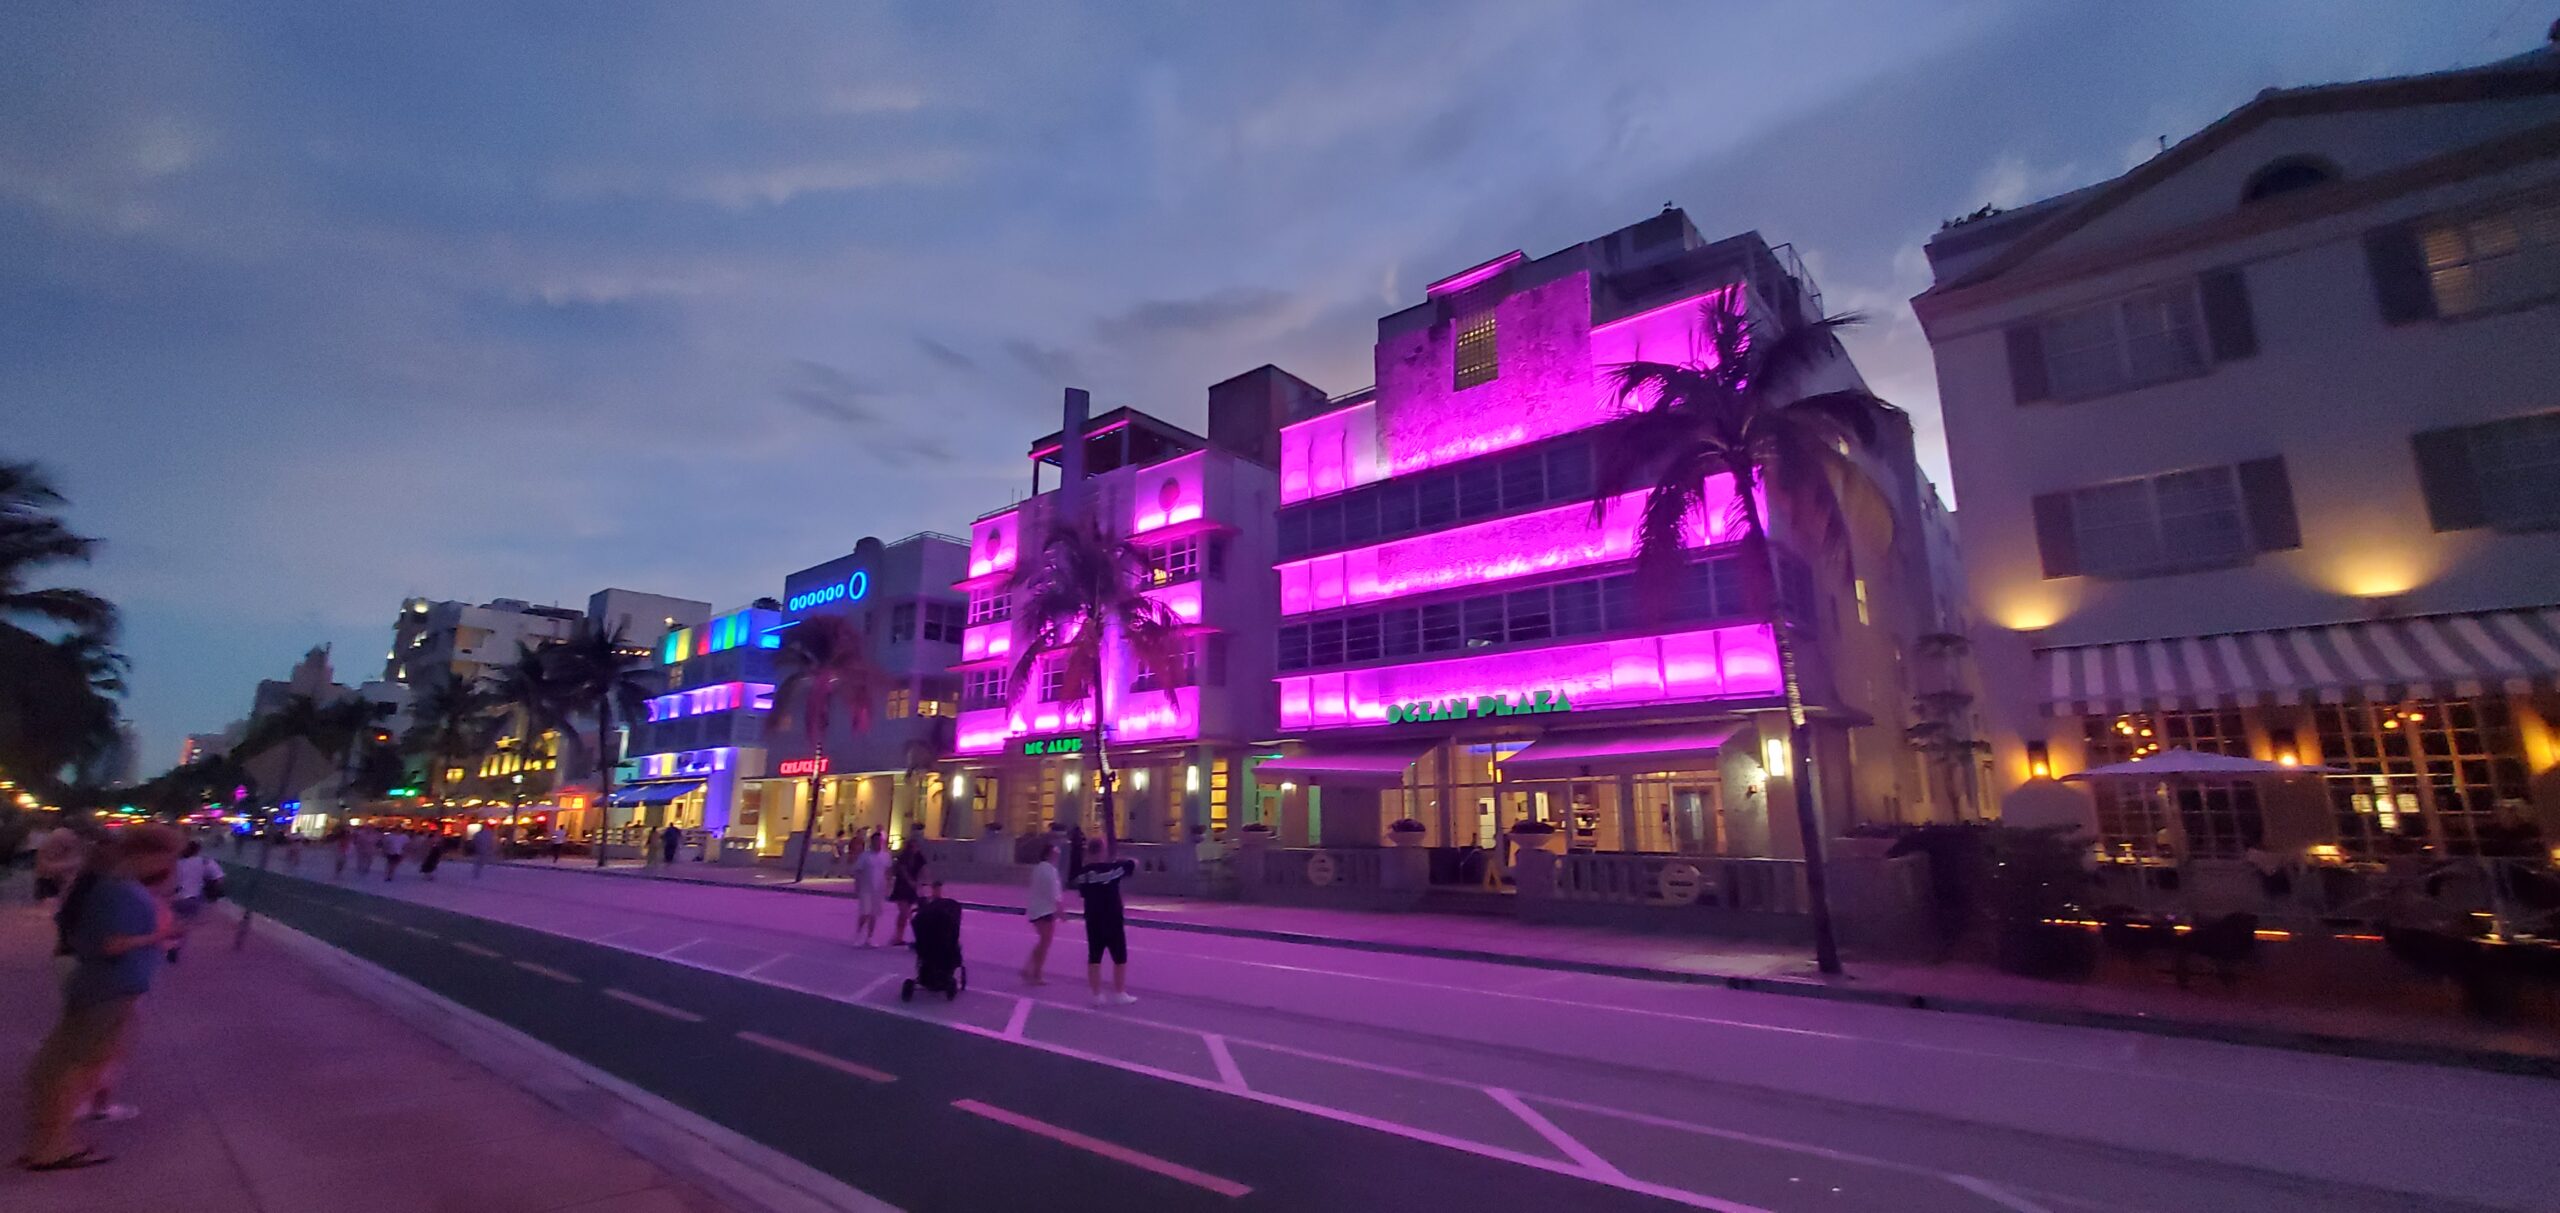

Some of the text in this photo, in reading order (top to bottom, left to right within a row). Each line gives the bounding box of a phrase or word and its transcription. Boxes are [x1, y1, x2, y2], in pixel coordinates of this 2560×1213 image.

[1386, 689, 1572, 724] OCEAN PLAZA
[1024, 740, 1045, 755] MC
